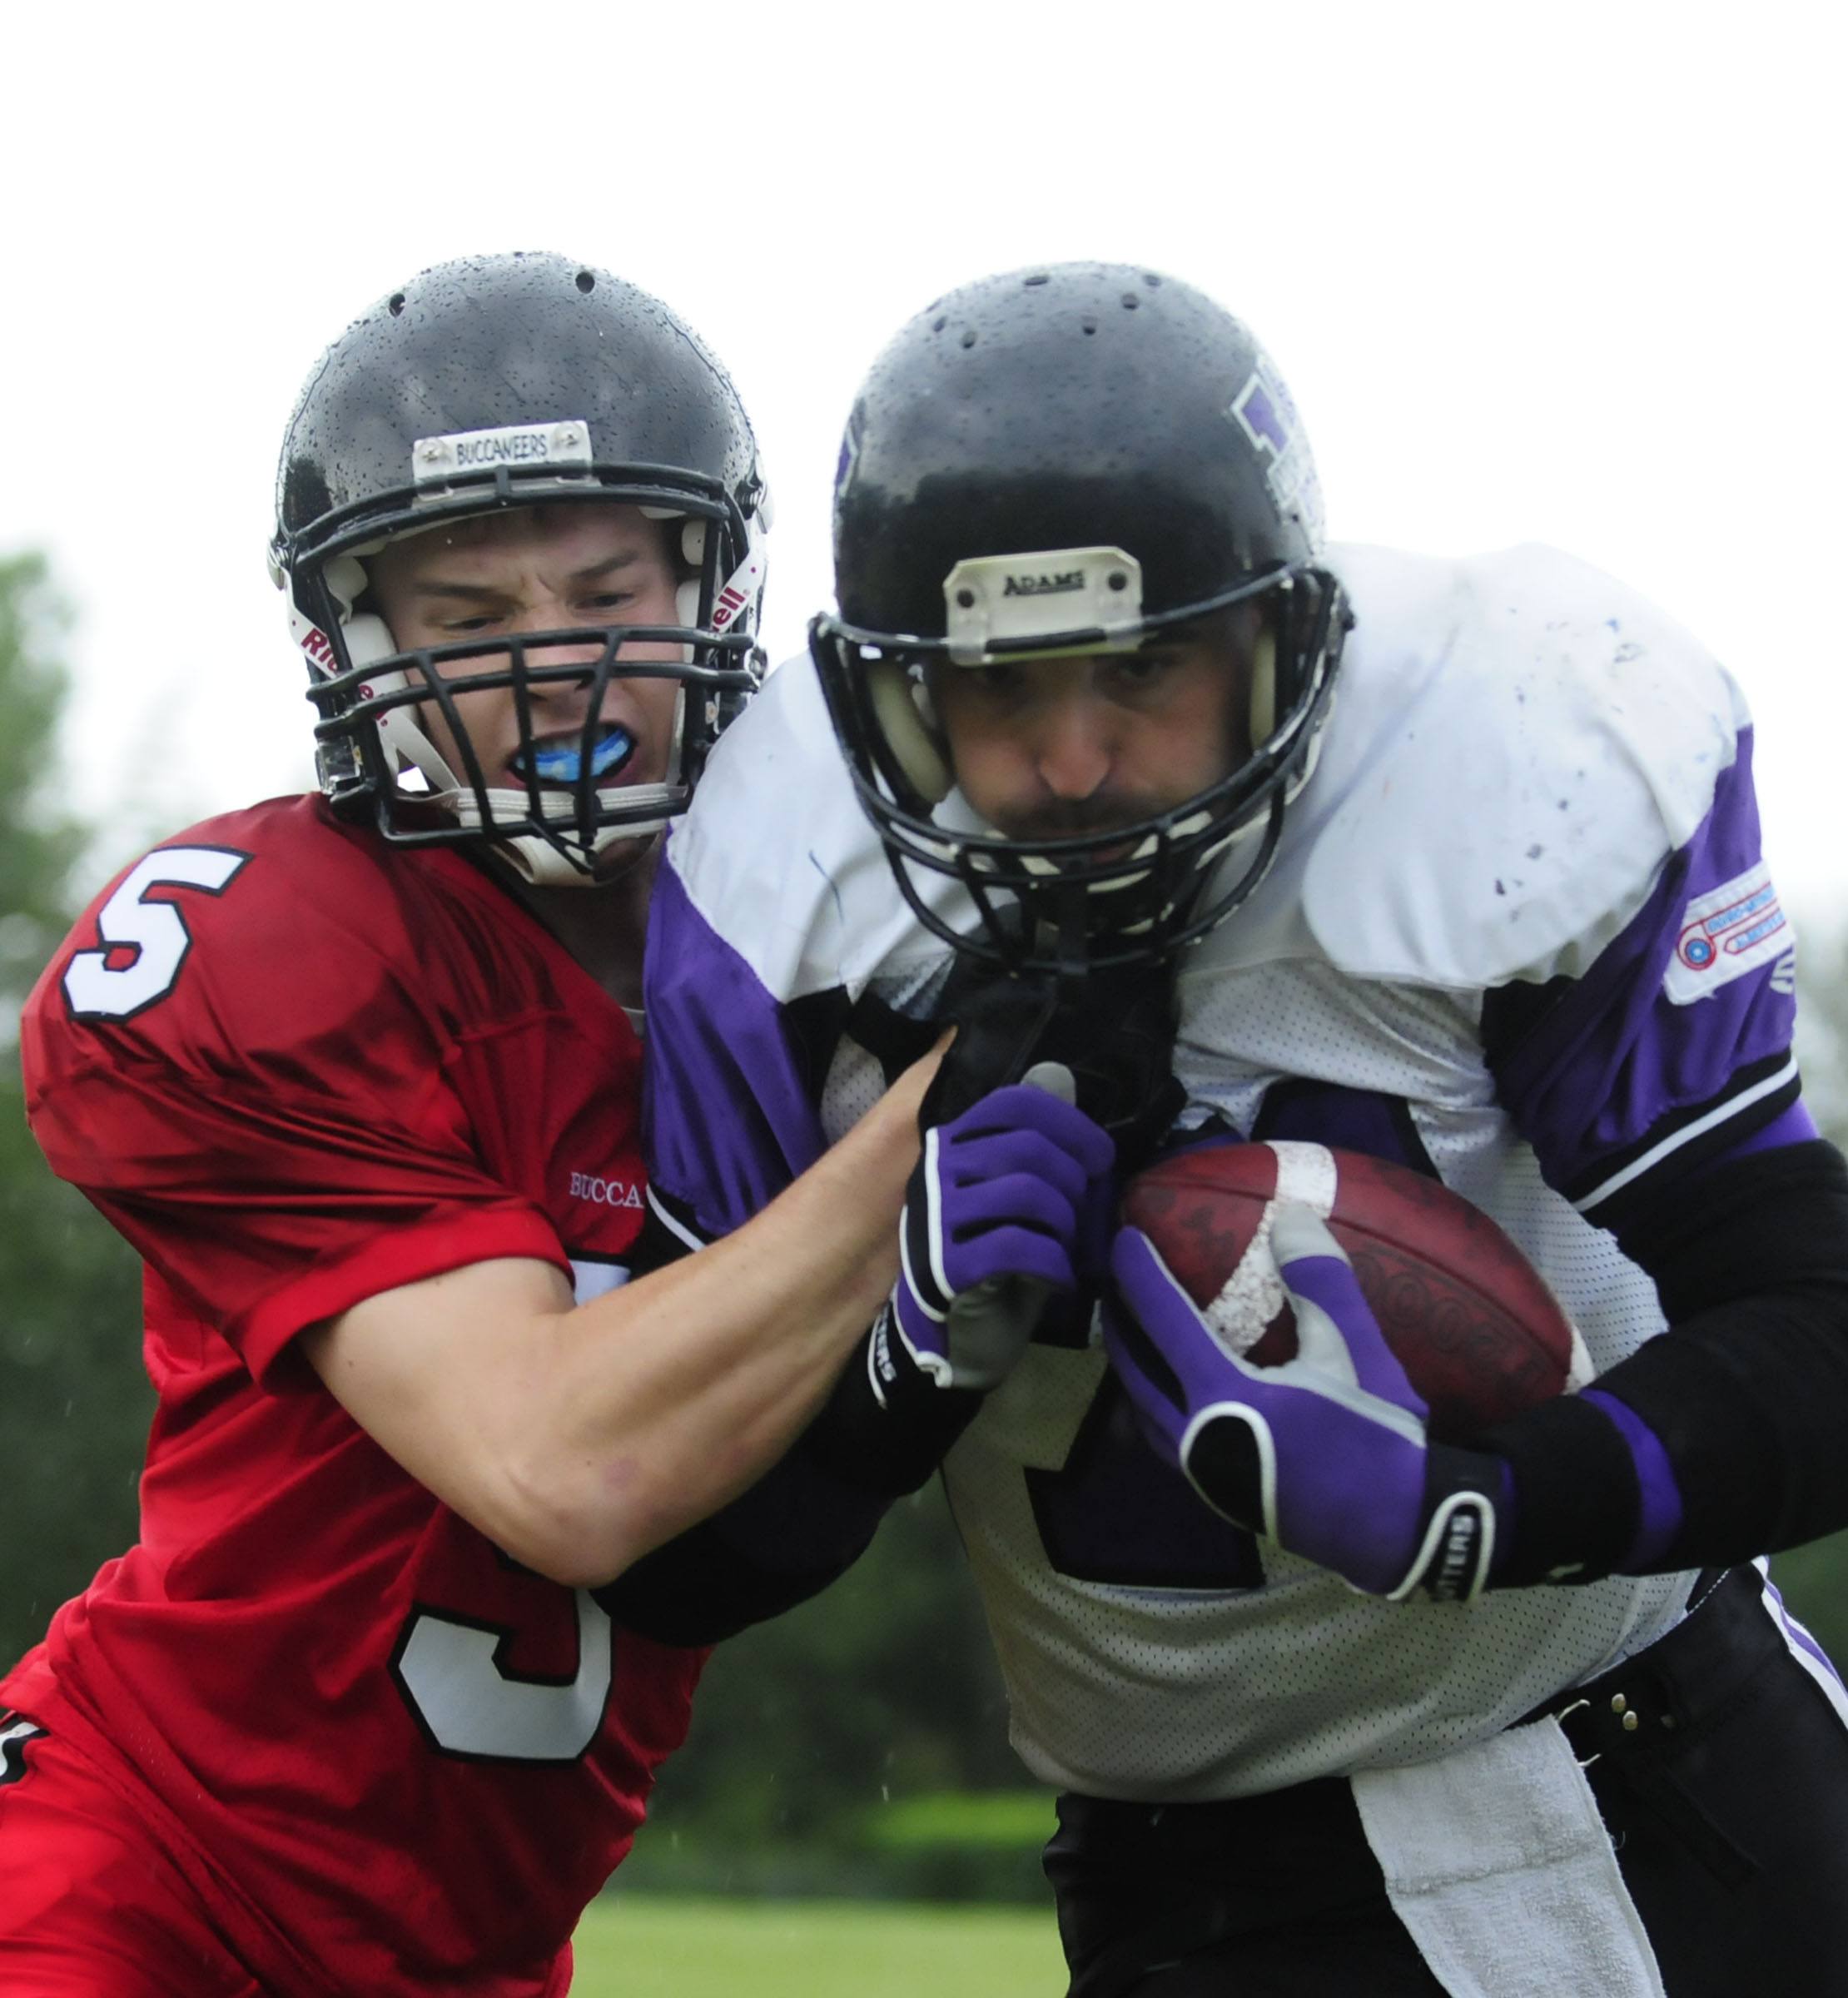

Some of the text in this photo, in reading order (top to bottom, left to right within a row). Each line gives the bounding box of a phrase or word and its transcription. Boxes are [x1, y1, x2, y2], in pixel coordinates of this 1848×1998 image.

[458, 434, 548, 465] BUCCANEERS
[1004, 569, 1085, 597] ADAMS
[60, 844, 254, 1022] 5
